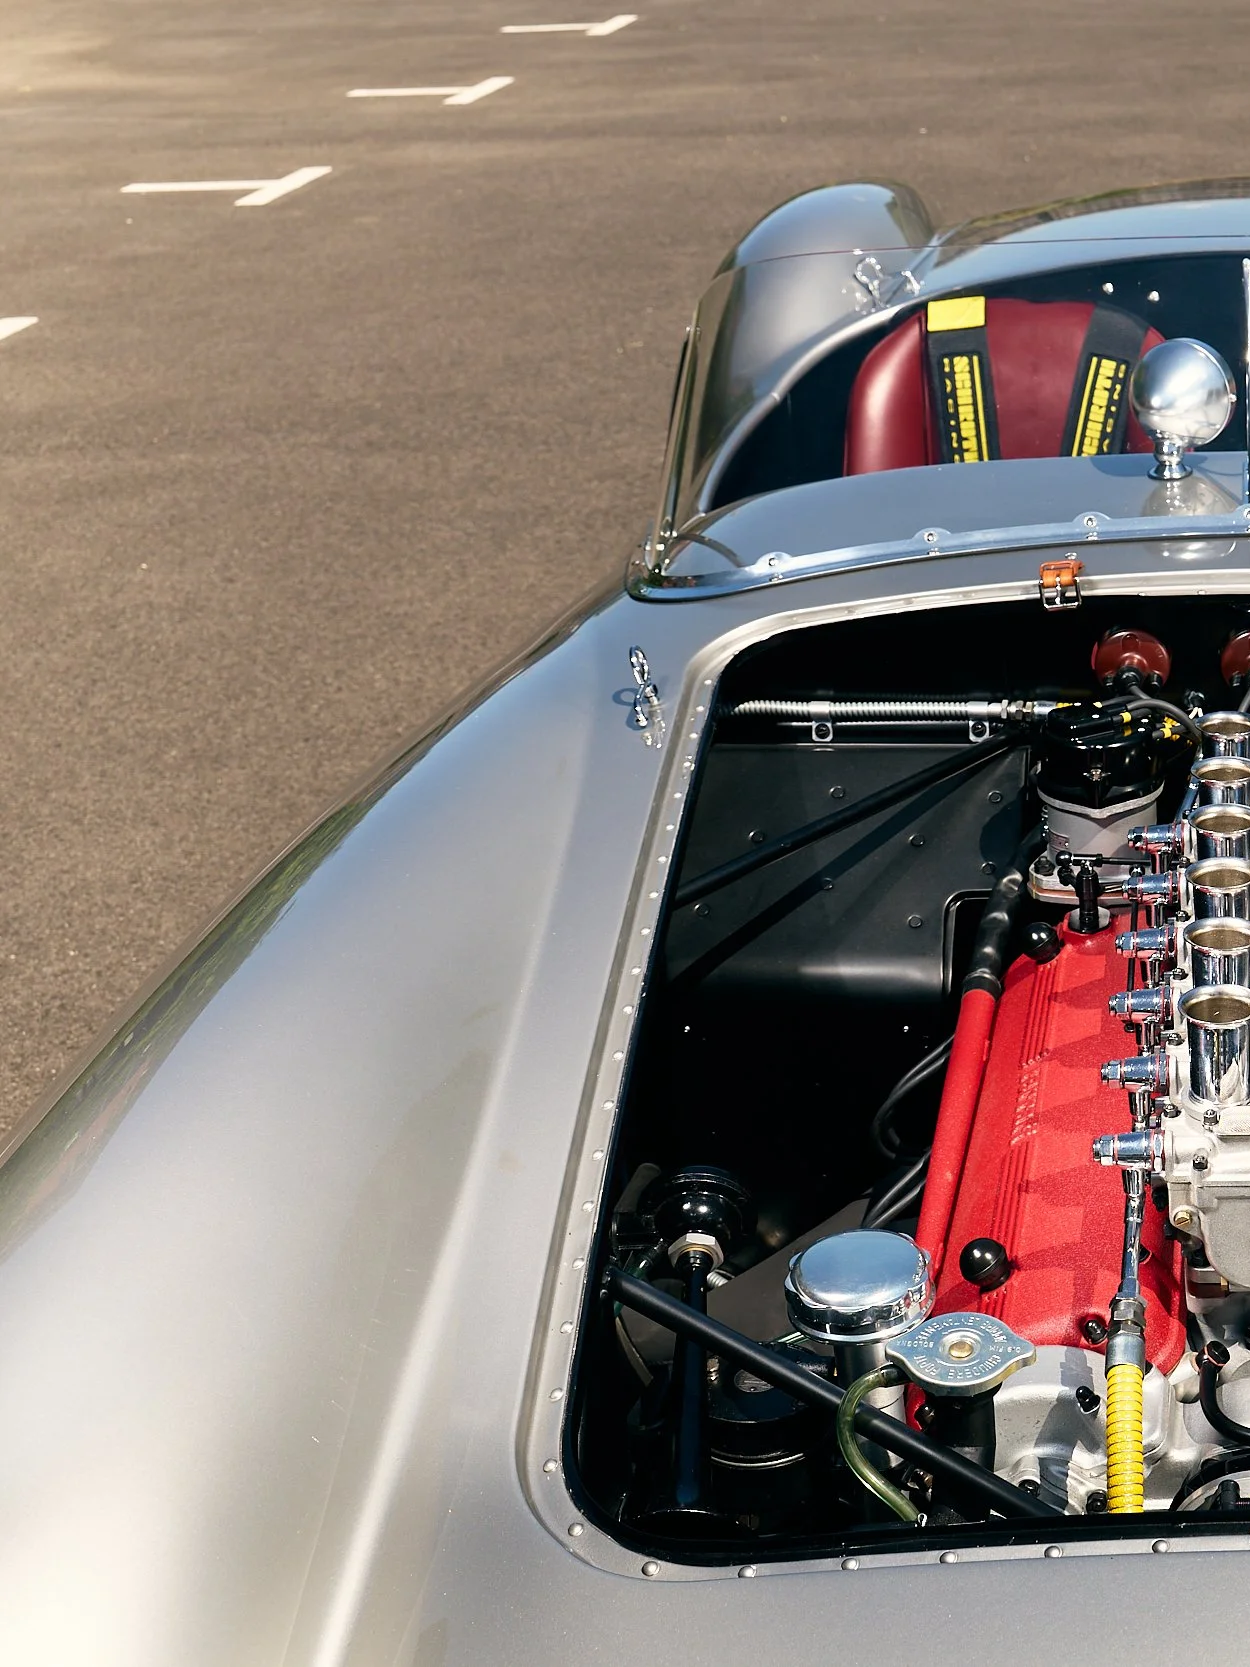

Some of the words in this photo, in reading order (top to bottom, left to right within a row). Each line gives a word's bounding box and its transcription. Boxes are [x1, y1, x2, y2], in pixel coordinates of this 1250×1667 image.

[1081, 358, 1116, 457] CHROTH
[896, 1340, 935, 1348] BOLOGNA
[947, 1354, 1002, 1379] CHIUDERE
